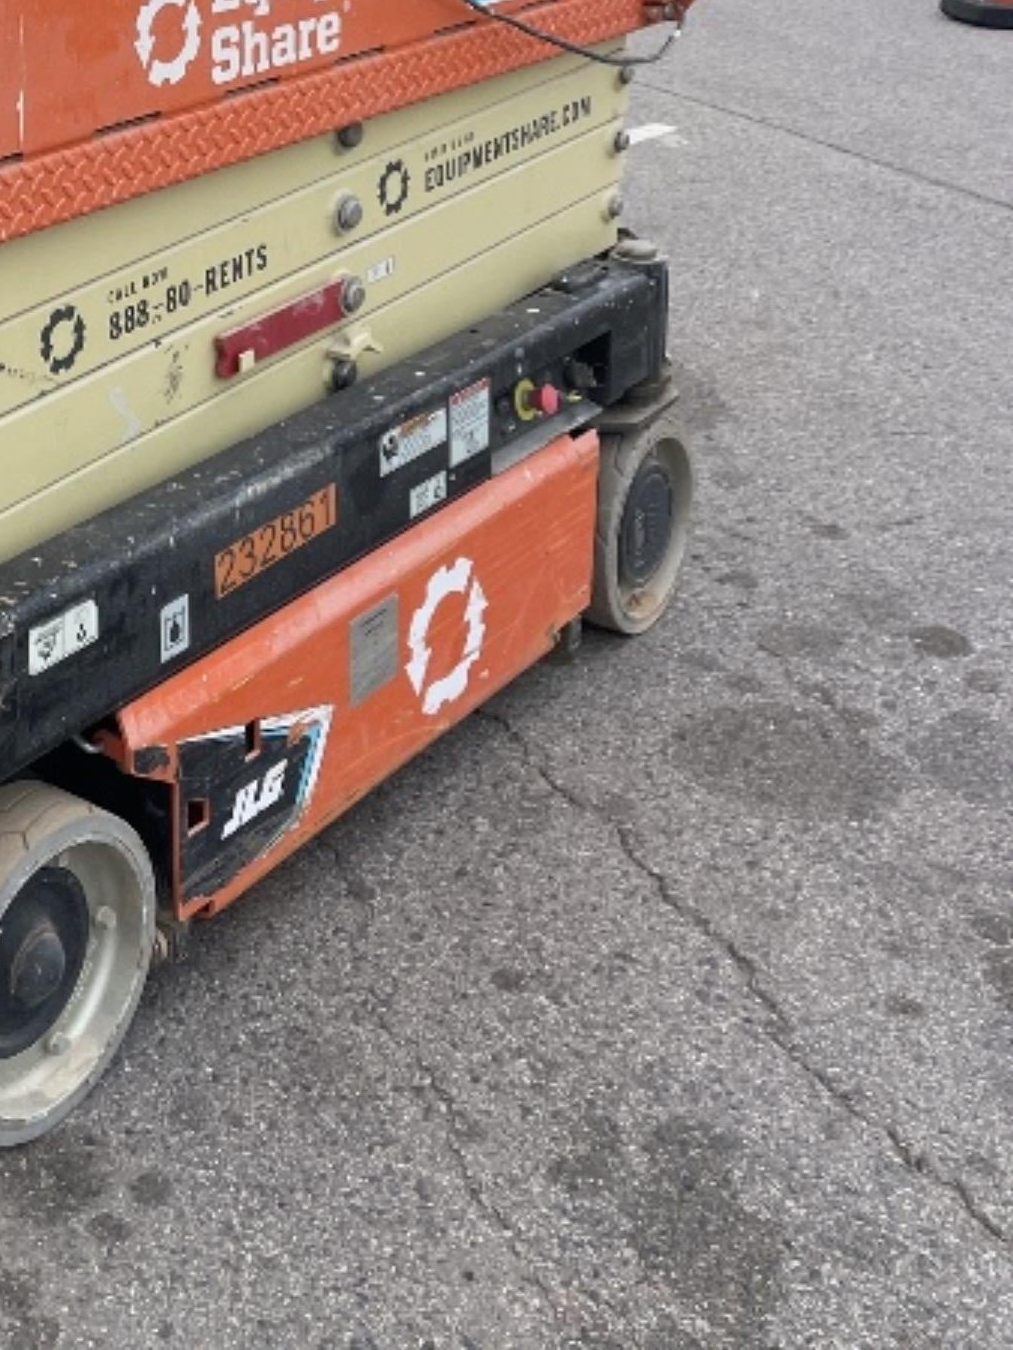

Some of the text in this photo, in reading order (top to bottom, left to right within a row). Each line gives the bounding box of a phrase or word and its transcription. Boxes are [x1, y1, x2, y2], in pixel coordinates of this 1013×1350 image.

[211, 11, 342, 84] Share
[424, 96, 592, 193] EQUIPMENTSHARE.COM
[217, 492, 331, 595] 232861
[220, 758, 288, 841] JLG
